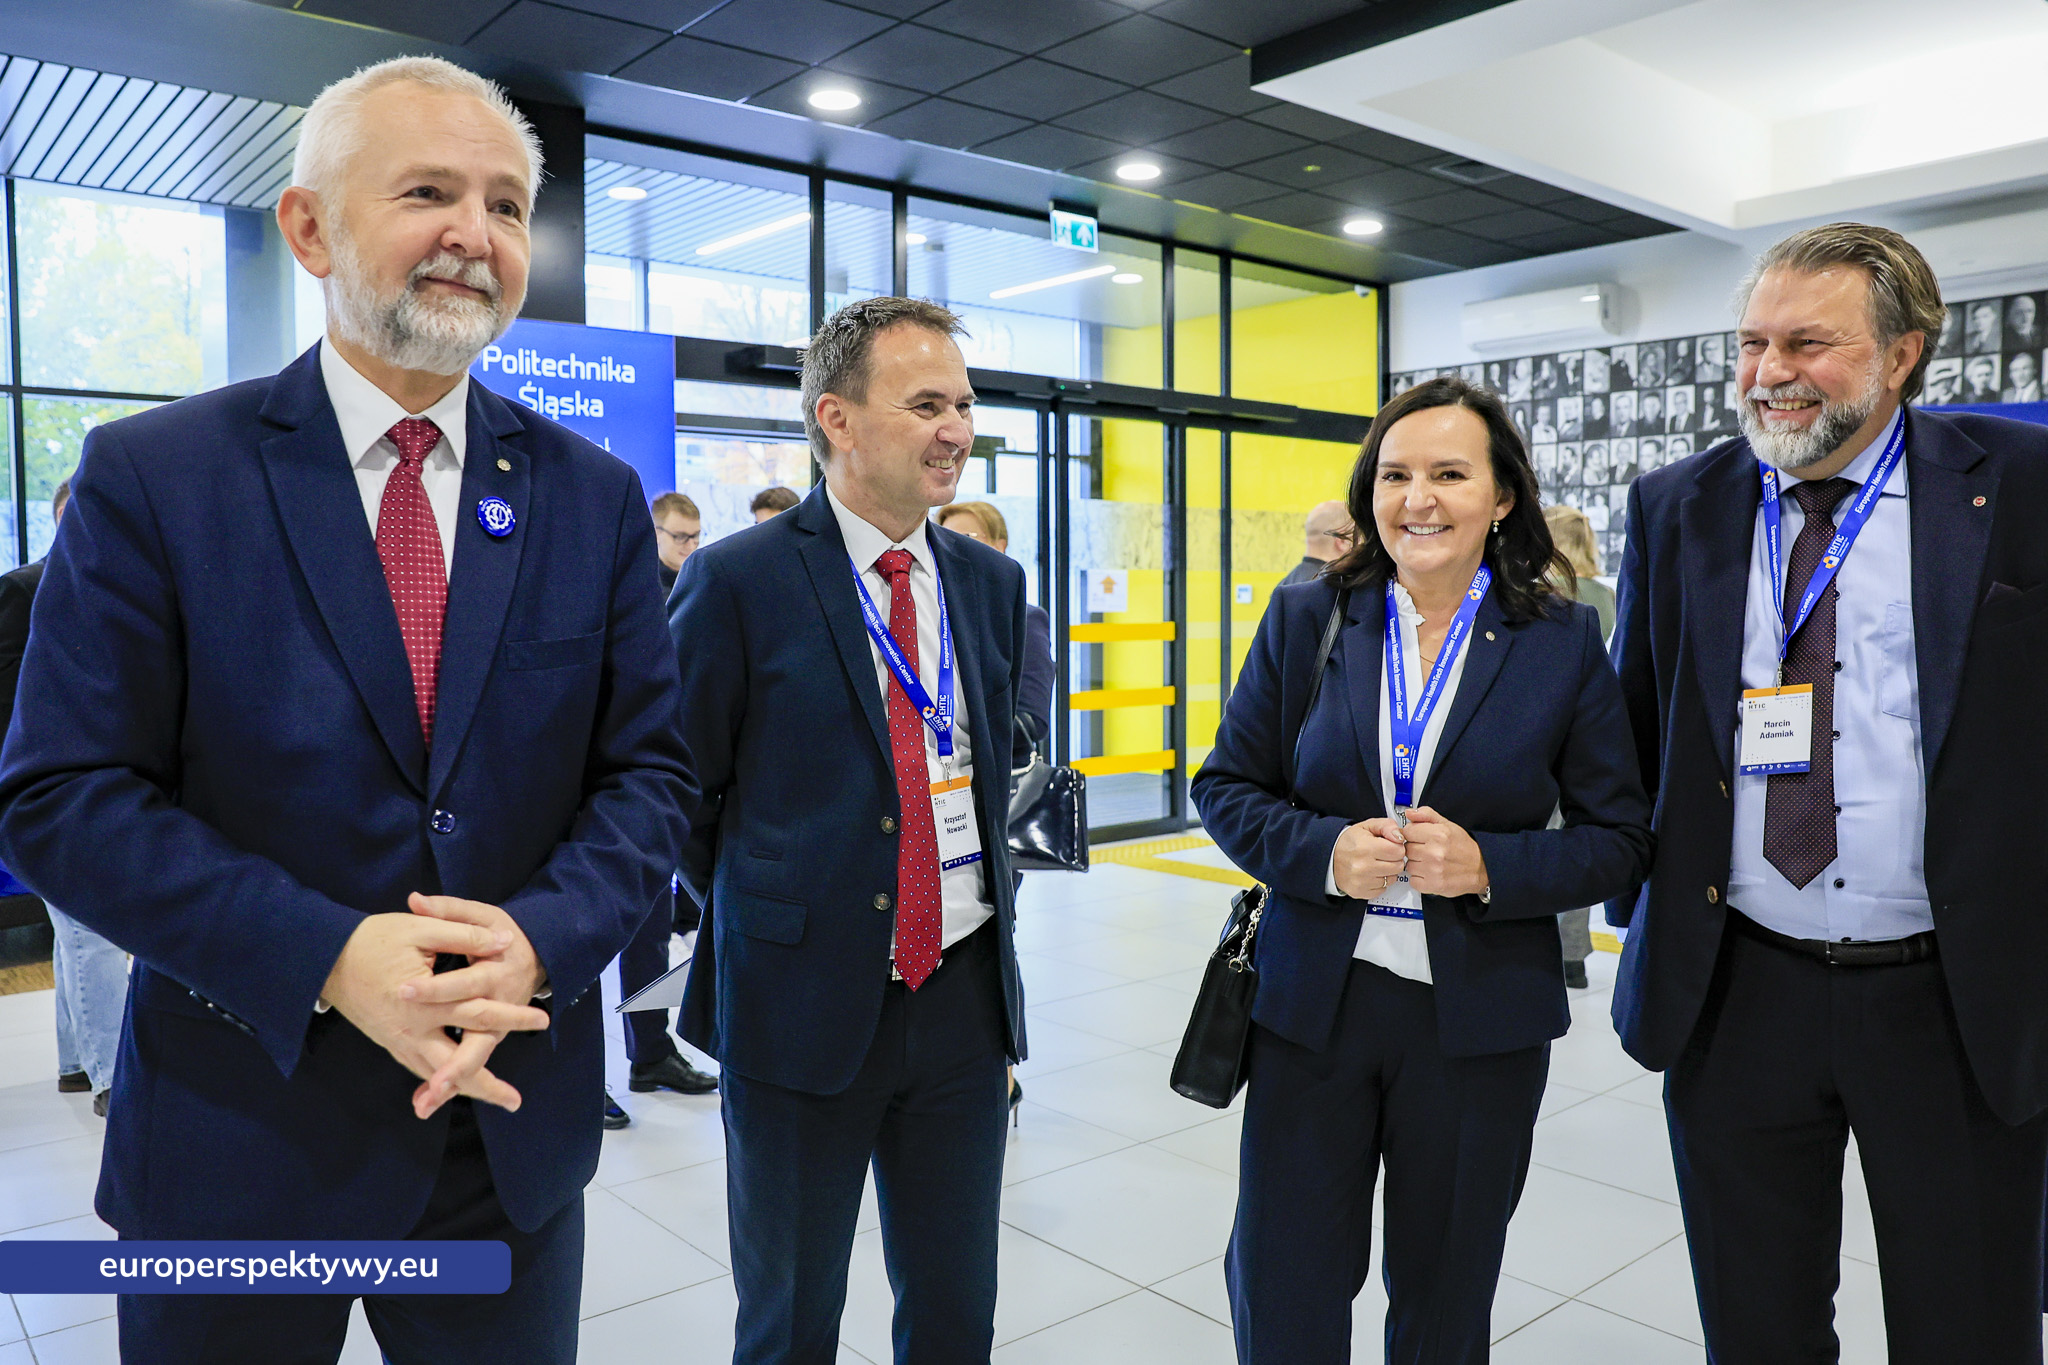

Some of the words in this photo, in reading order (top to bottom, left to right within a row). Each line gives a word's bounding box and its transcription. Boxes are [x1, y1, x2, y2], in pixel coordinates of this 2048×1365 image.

[482, 345, 636, 384] Politechnika
[518, 380, 604, 421] Śląska
[1854, 482, 1877, 514] European
[1871, 454, 1893, 487] HealthTech
[1889, 428, 1905, 456] Innovatio
[1828, 534, 1845, 555] EHTIC
[1471, 569, 1485, 589] EHTIC
[1800, 591, 1815, 614] Center
[862, 602, 884, 636] HealthTech
[880, 634, 902, 667] Innovation
[899, 664, 914, 685] Center
[1415, 697, 1432, 722] European
[1426, 667, 1444, 699] HealthTech
[1439, 639, 1456, 669] Innovation
[1450, 619, 1464, 640] Center
[939, 695, 947, 716] EHTIC
[932, 715, 947, 732] EHTIC
[1764, 720, 1791, 729] Marcin
[1760, 730, 1794, 740] Adamiak
[1402, 757, 1410, 779] EHTIC
[943, 812, 967, 825] Krzysztof
[946, 822, 968, 835] Nowacki
